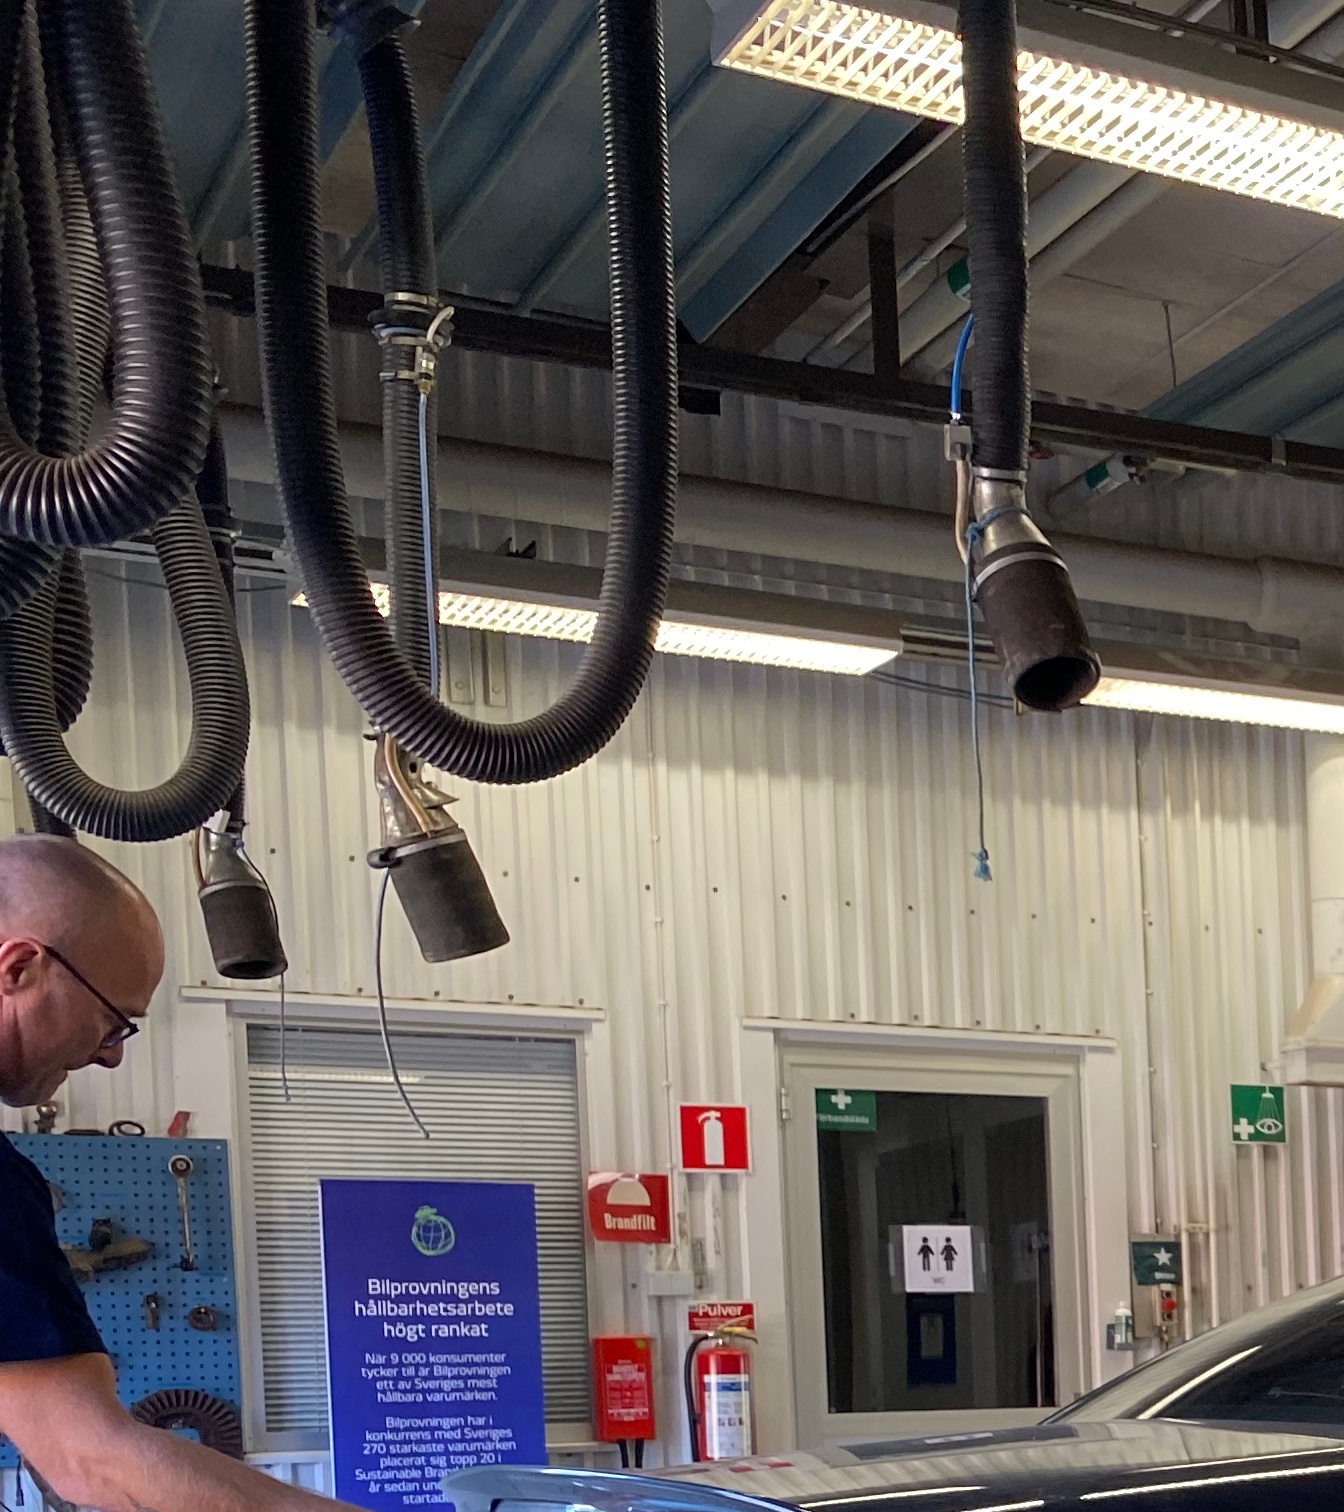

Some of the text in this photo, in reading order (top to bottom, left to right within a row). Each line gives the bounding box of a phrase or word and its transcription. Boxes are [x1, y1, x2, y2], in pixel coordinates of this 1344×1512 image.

[604, 1213, 656, 1231] Brandfilt
[368, 1278, 500, 1299] Bilprovningens
[354, 1299, 514, 1317] hållbarhetsarbete
[698, 1303, 743, 1317] Pulver
[383, 1322, 489, 1342] högt rankat
[365, 1352, 506, 1364] När 9 000 konsumenter
[361, 1364, 511, 1381] tycker till är Bilprovningen
[376, 1378, 498, 1393] ett av Sveriges mest
[378, 1390, 498, 1403] hållbara varumärken.
[386, 1416, 464, 1430] Bilprovningen
[467, 1415, 486, 1427] har
[366, 1428, 512, 1443] konkurrens med Sveriges
[363, 1440, 516, 1455] 270 starkaste varumärken
[380, 1455, 427, 1468] placerat
[430, 1454, 448, 1468] sig
[450, 1453, 478, 1468] topp
[480, 1453, 496, 1464] 20
[355, 1467, 422, 1481] Sustainable
[369, 1479, 381, 1493] år
[384, 1480, 420, 1493] sedan
